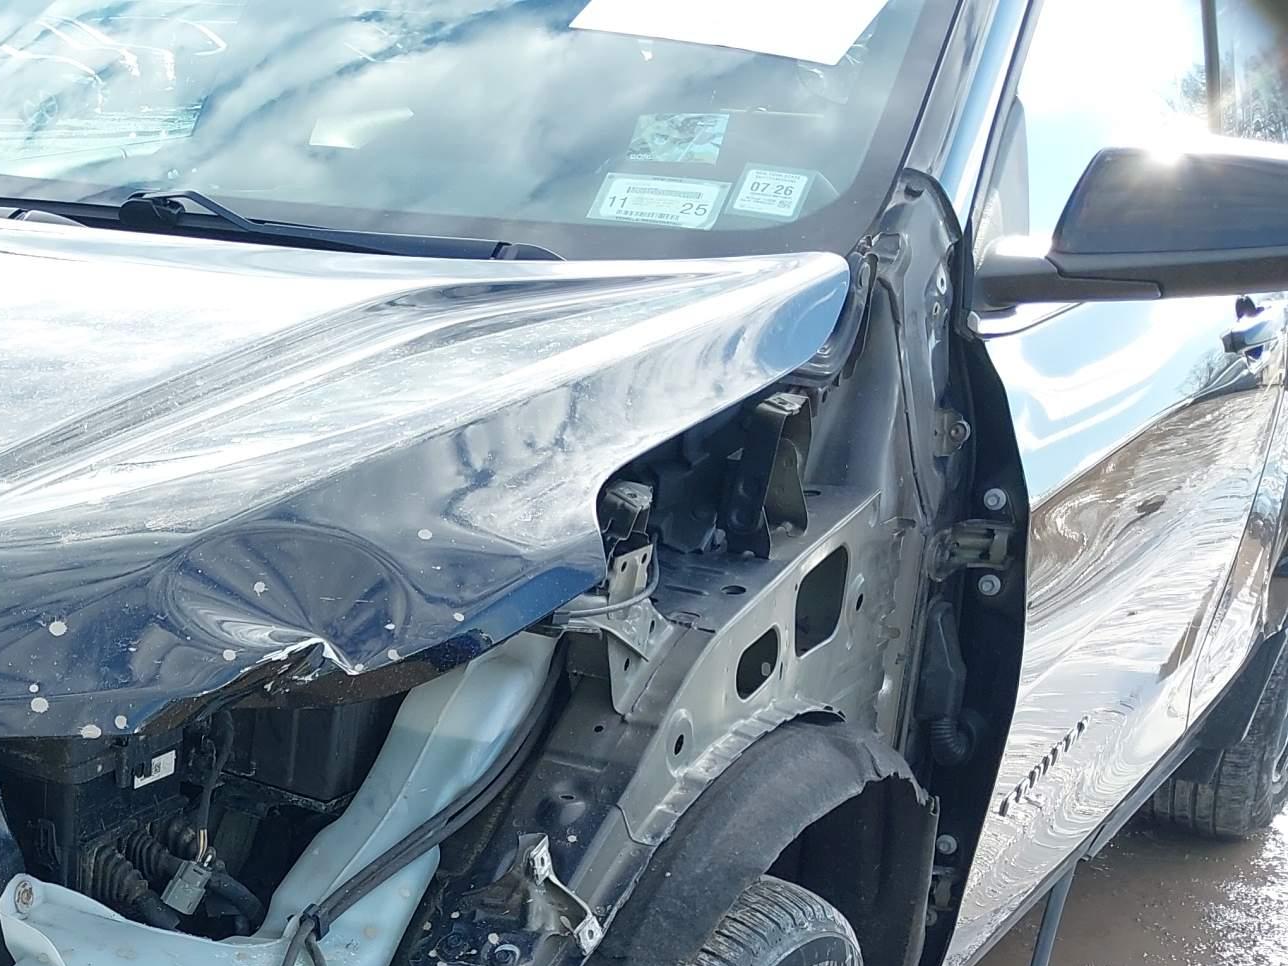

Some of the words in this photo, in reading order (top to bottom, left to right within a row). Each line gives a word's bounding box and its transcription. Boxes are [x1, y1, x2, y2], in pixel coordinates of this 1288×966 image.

[750, 181, 770, 193] 07
[773, 184, 794, 197] 26
[609, 195, 628, 209] 11
[679, 202, 709, 217] 25
